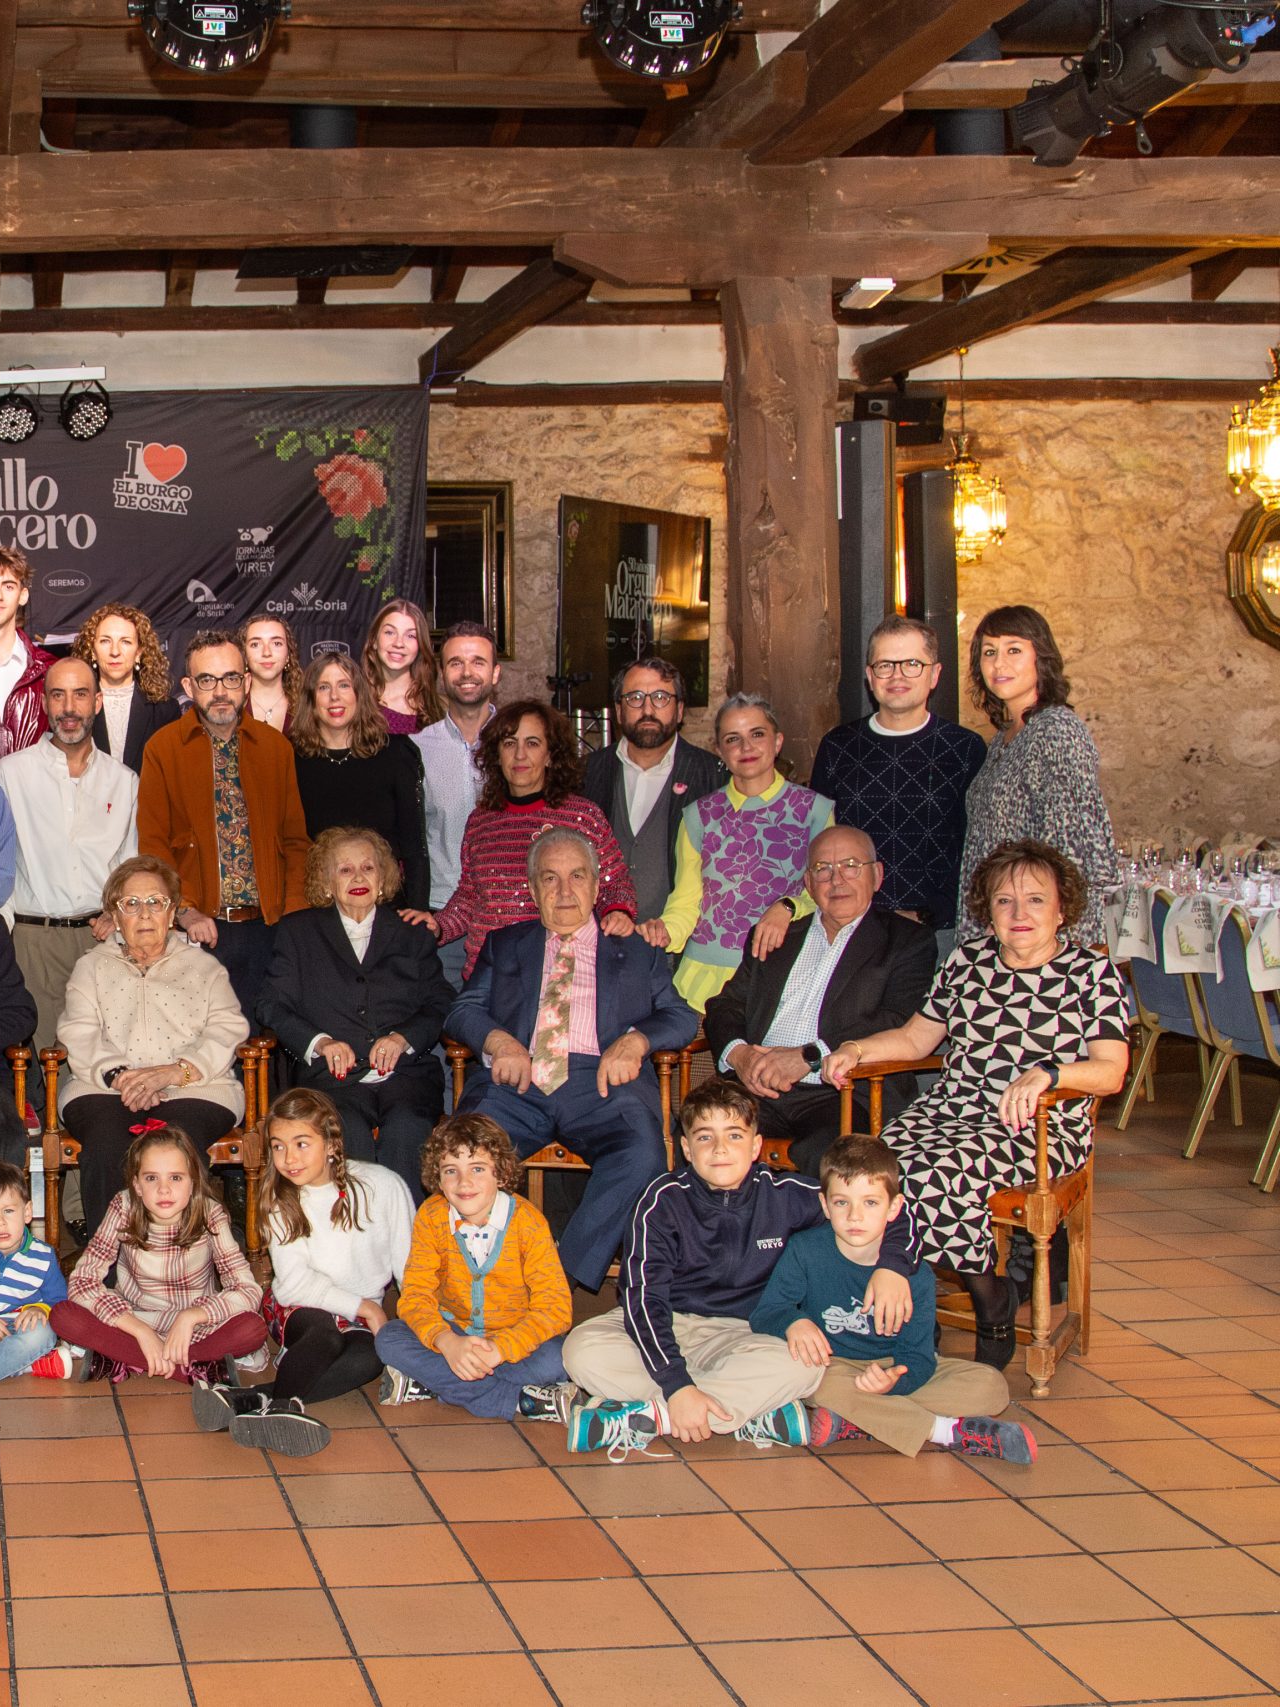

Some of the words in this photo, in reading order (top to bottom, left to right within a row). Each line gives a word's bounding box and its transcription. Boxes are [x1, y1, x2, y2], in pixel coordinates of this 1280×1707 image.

[663, 29, 681, 37] JVF
[124, 441, 142, 480] I
[114, 480, 133, 494] EL
[135, 482, 191, 501] BURGO
[116, 494, 137, 508] DE
[139, 496, 187, 514] OSMA
[235, 561, 275, 573] VIRREY
[48, 579, 85, 587] SEREMOS
[266, 600, 295, 614] Caja
[314, 600, 348, 611] Soria
[757, 1241, 783, 1249] TOKYO
